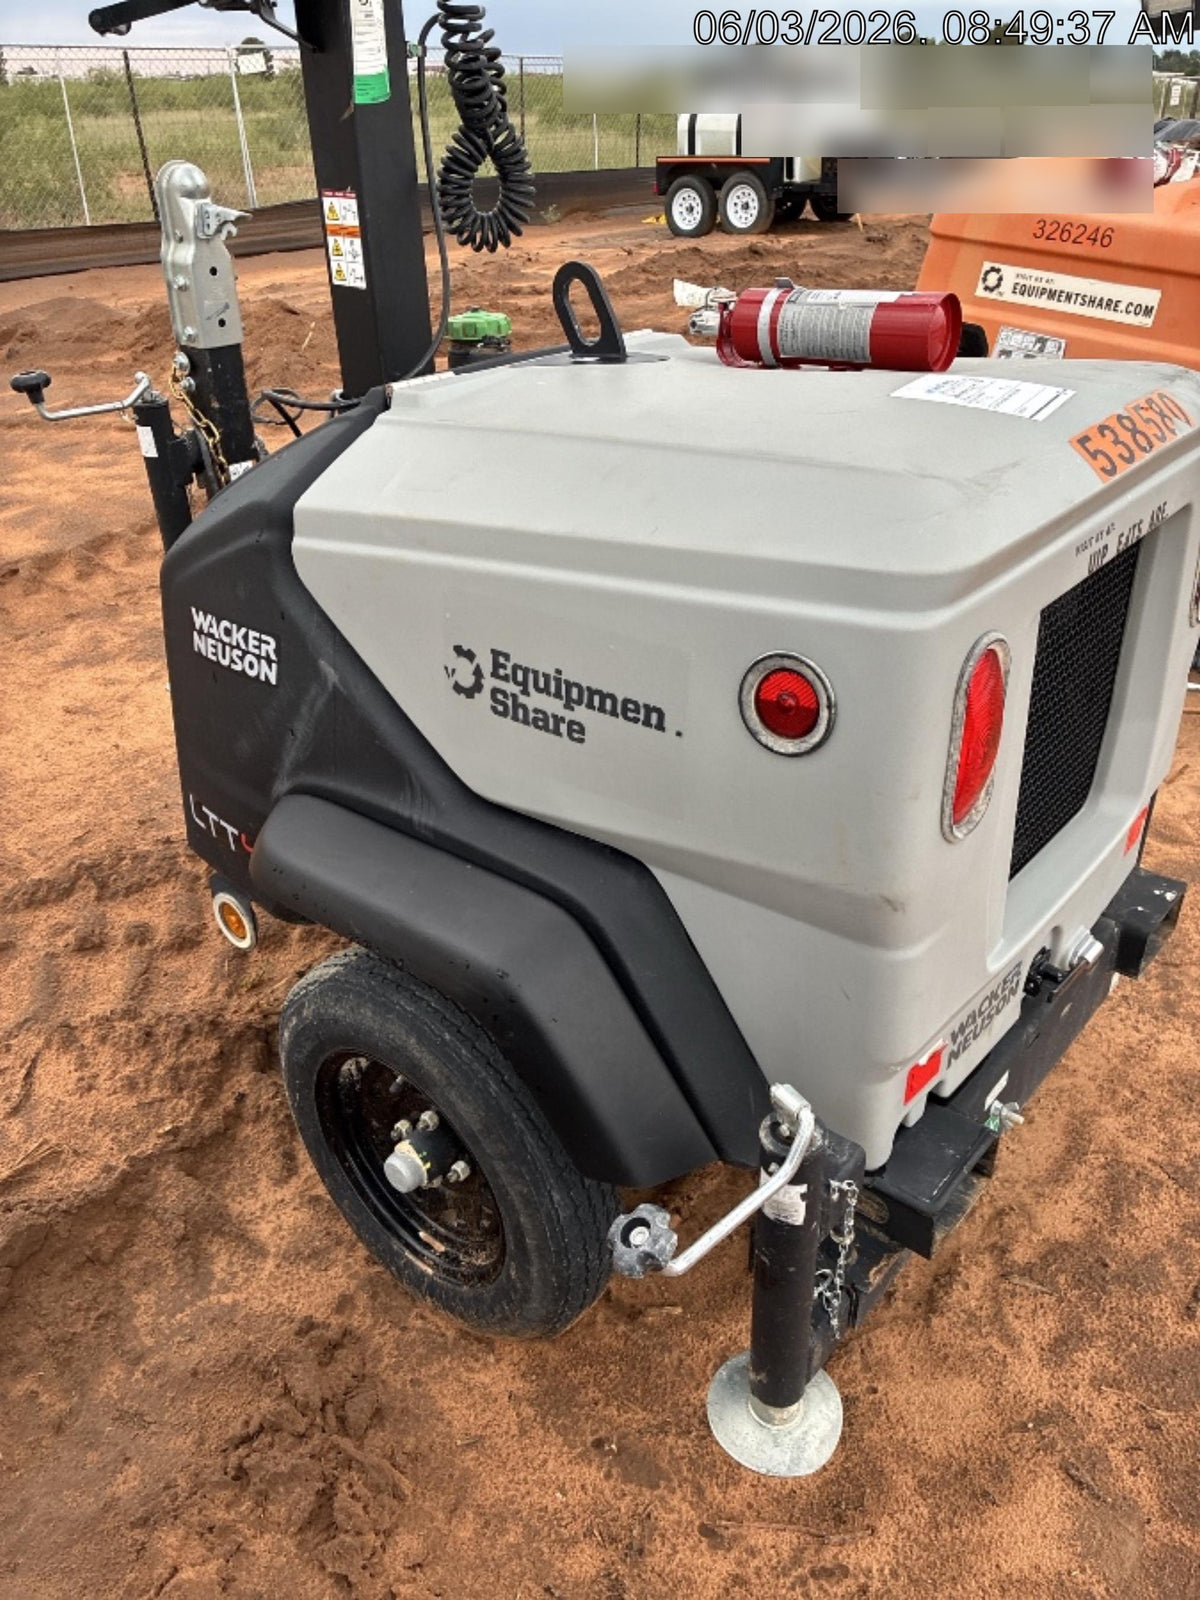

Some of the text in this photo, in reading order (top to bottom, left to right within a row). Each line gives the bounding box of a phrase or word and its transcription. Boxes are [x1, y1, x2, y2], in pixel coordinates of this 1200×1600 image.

[1032, 218, 1115, 248] 326246
[1011, 282, 1155, 319] EQUIPMENTSHARE.COM
[1076, 392, 1193, 478] 538580
[190, 606, 277, 662] WACKER
[193, 631, 278, 686] NEUSON
[490, 686, 586, 744] Share
[946, 980, 1020, 1070] NEUSON
[951, 960, 1022, 1046] WACKER
